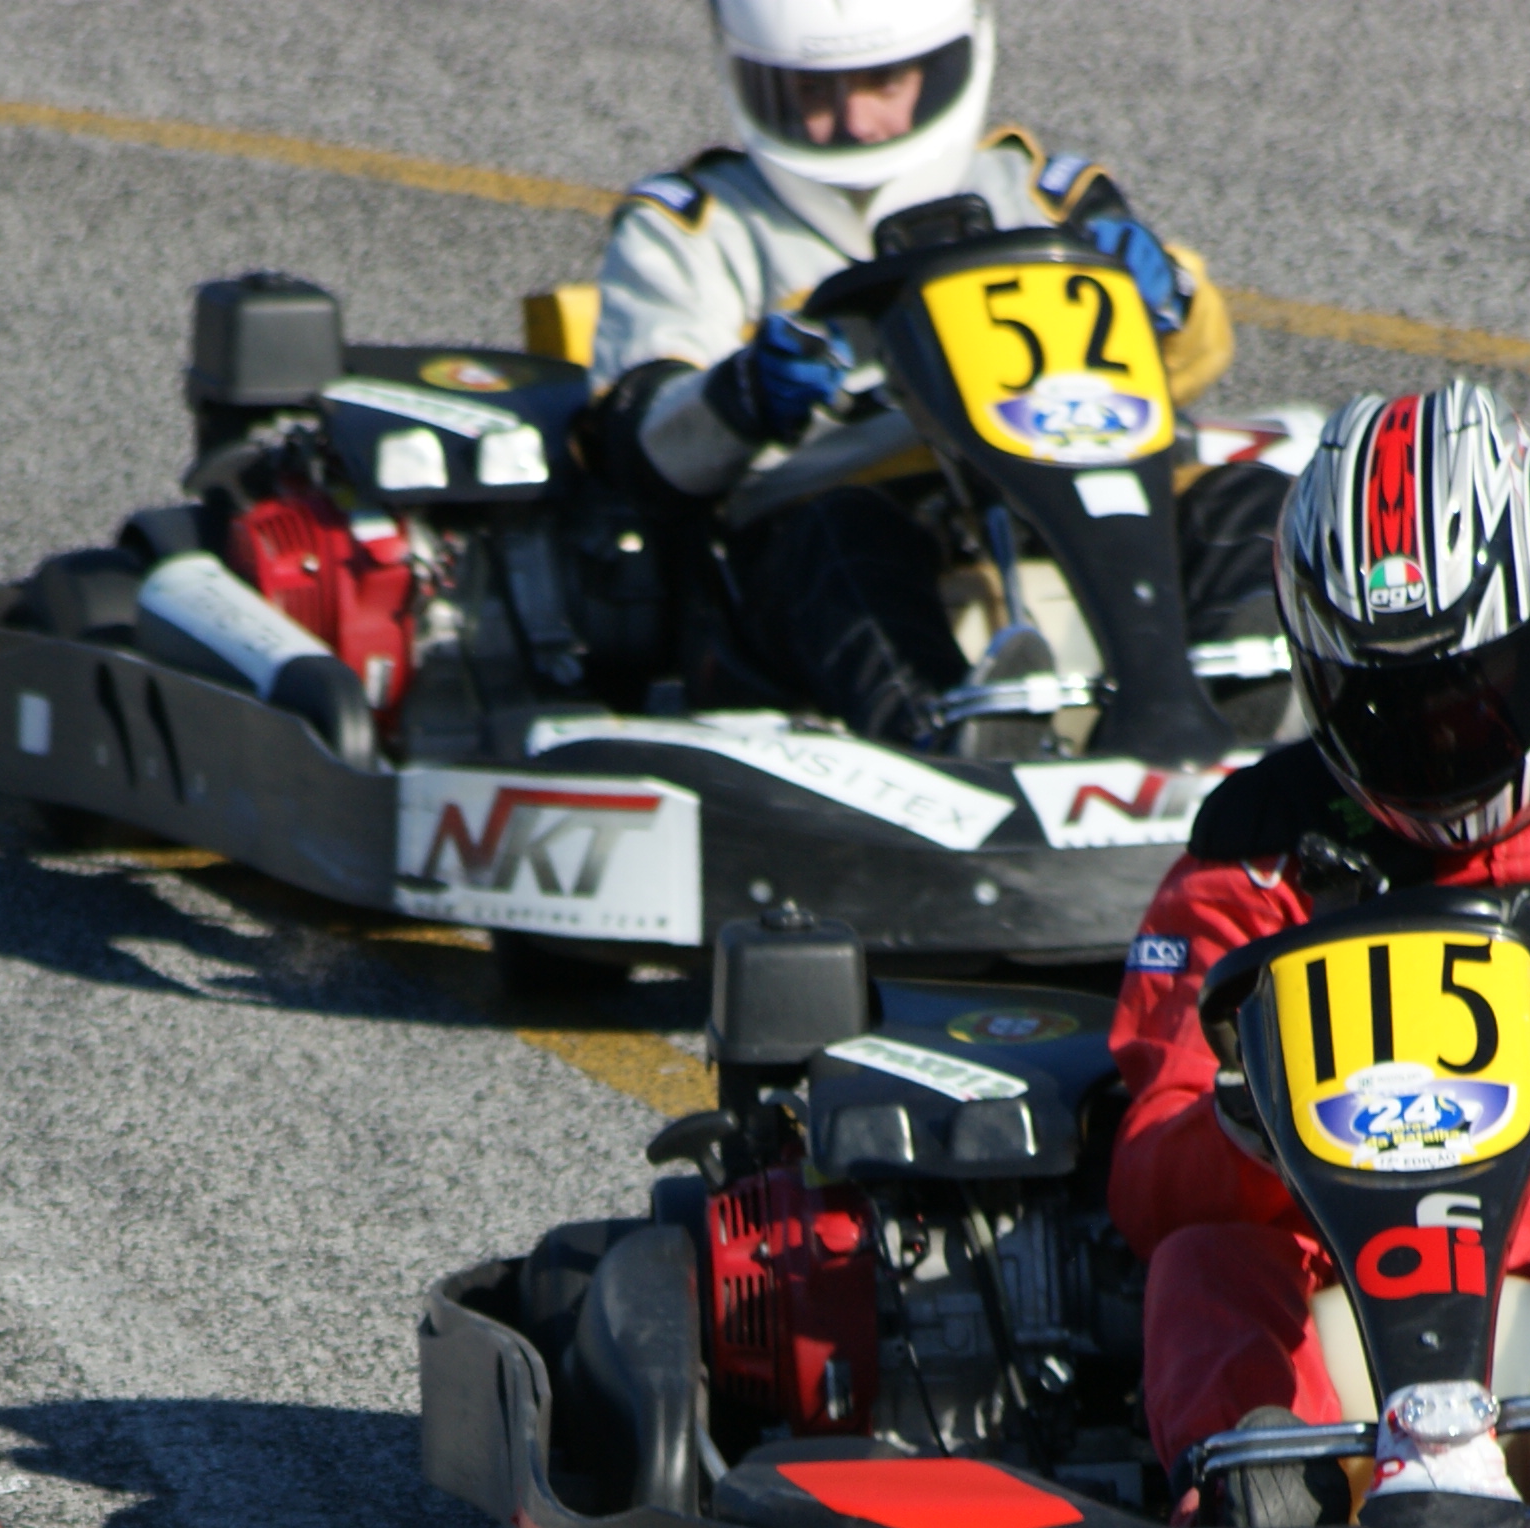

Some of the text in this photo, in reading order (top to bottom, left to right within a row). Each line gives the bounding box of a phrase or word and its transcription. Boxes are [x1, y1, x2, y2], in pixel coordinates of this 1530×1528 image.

[982, 272, 1131, 393] 52
[1370, 582, 1425, 608] agv
[421, 787, 662, 898] NKT
[1305, 938, 1499, 1085] 115
[1368, 1094, 1441, 1134] 24
